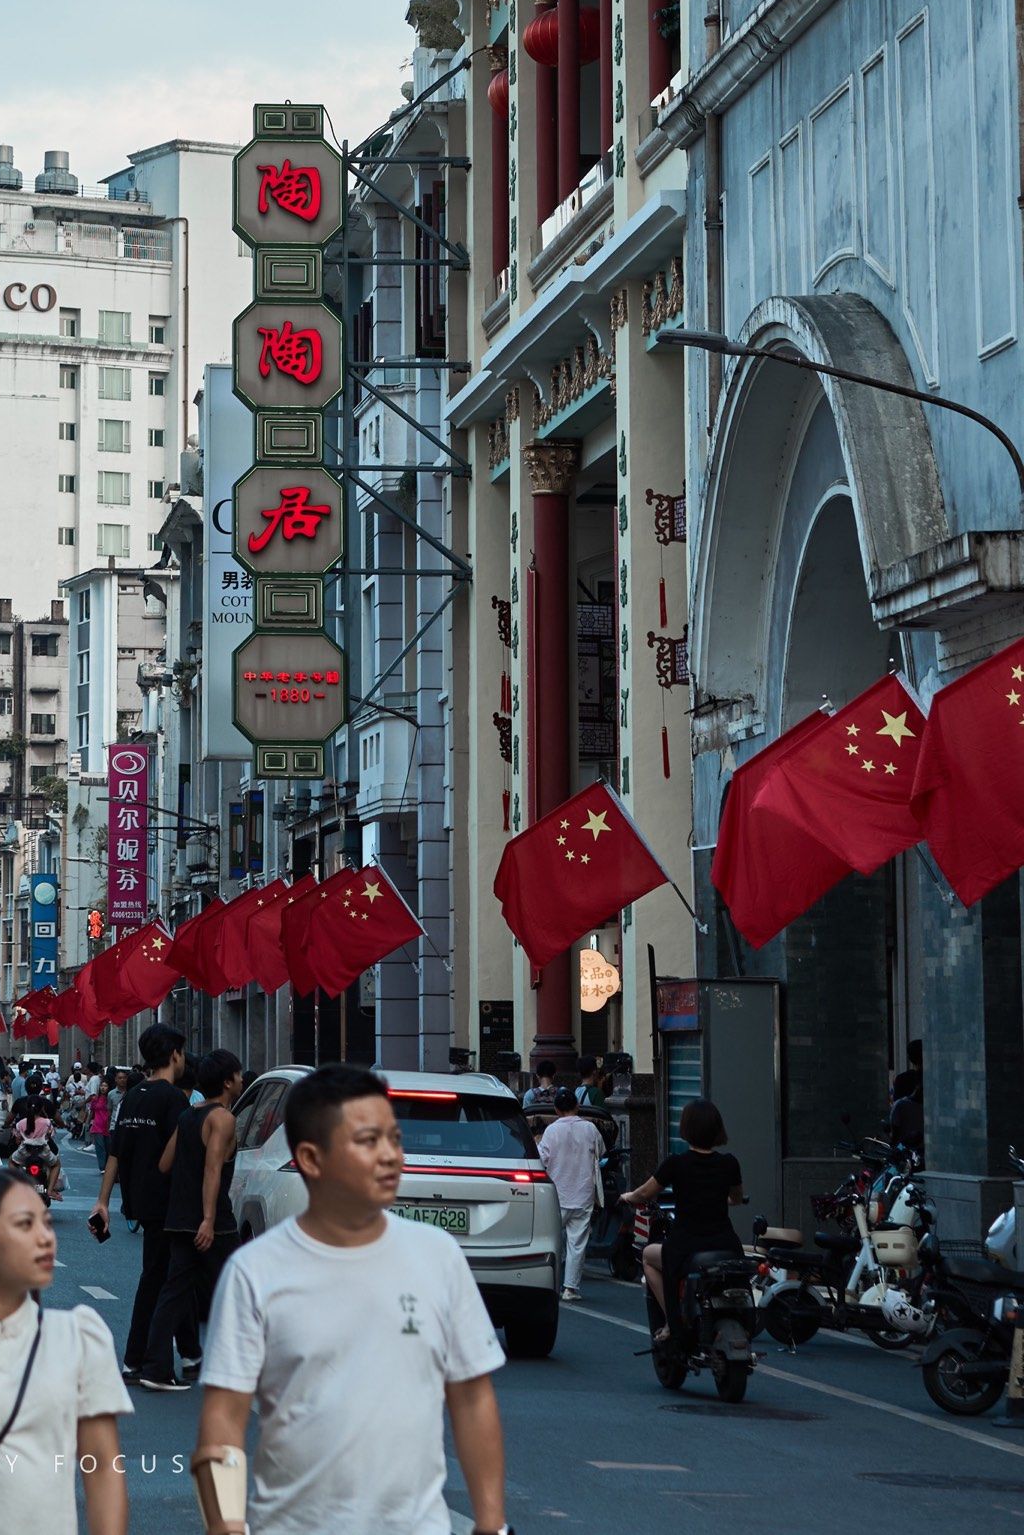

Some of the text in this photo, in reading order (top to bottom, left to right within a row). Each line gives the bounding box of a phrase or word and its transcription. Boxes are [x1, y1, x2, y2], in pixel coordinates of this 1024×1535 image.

[247, 158, 332, 554] 陶陶居
[116, 780, 140, 891] 贝尔妮芬
[113, 900, 142, 909] 加盟热线
[34, 922, 56, 974] 回力
